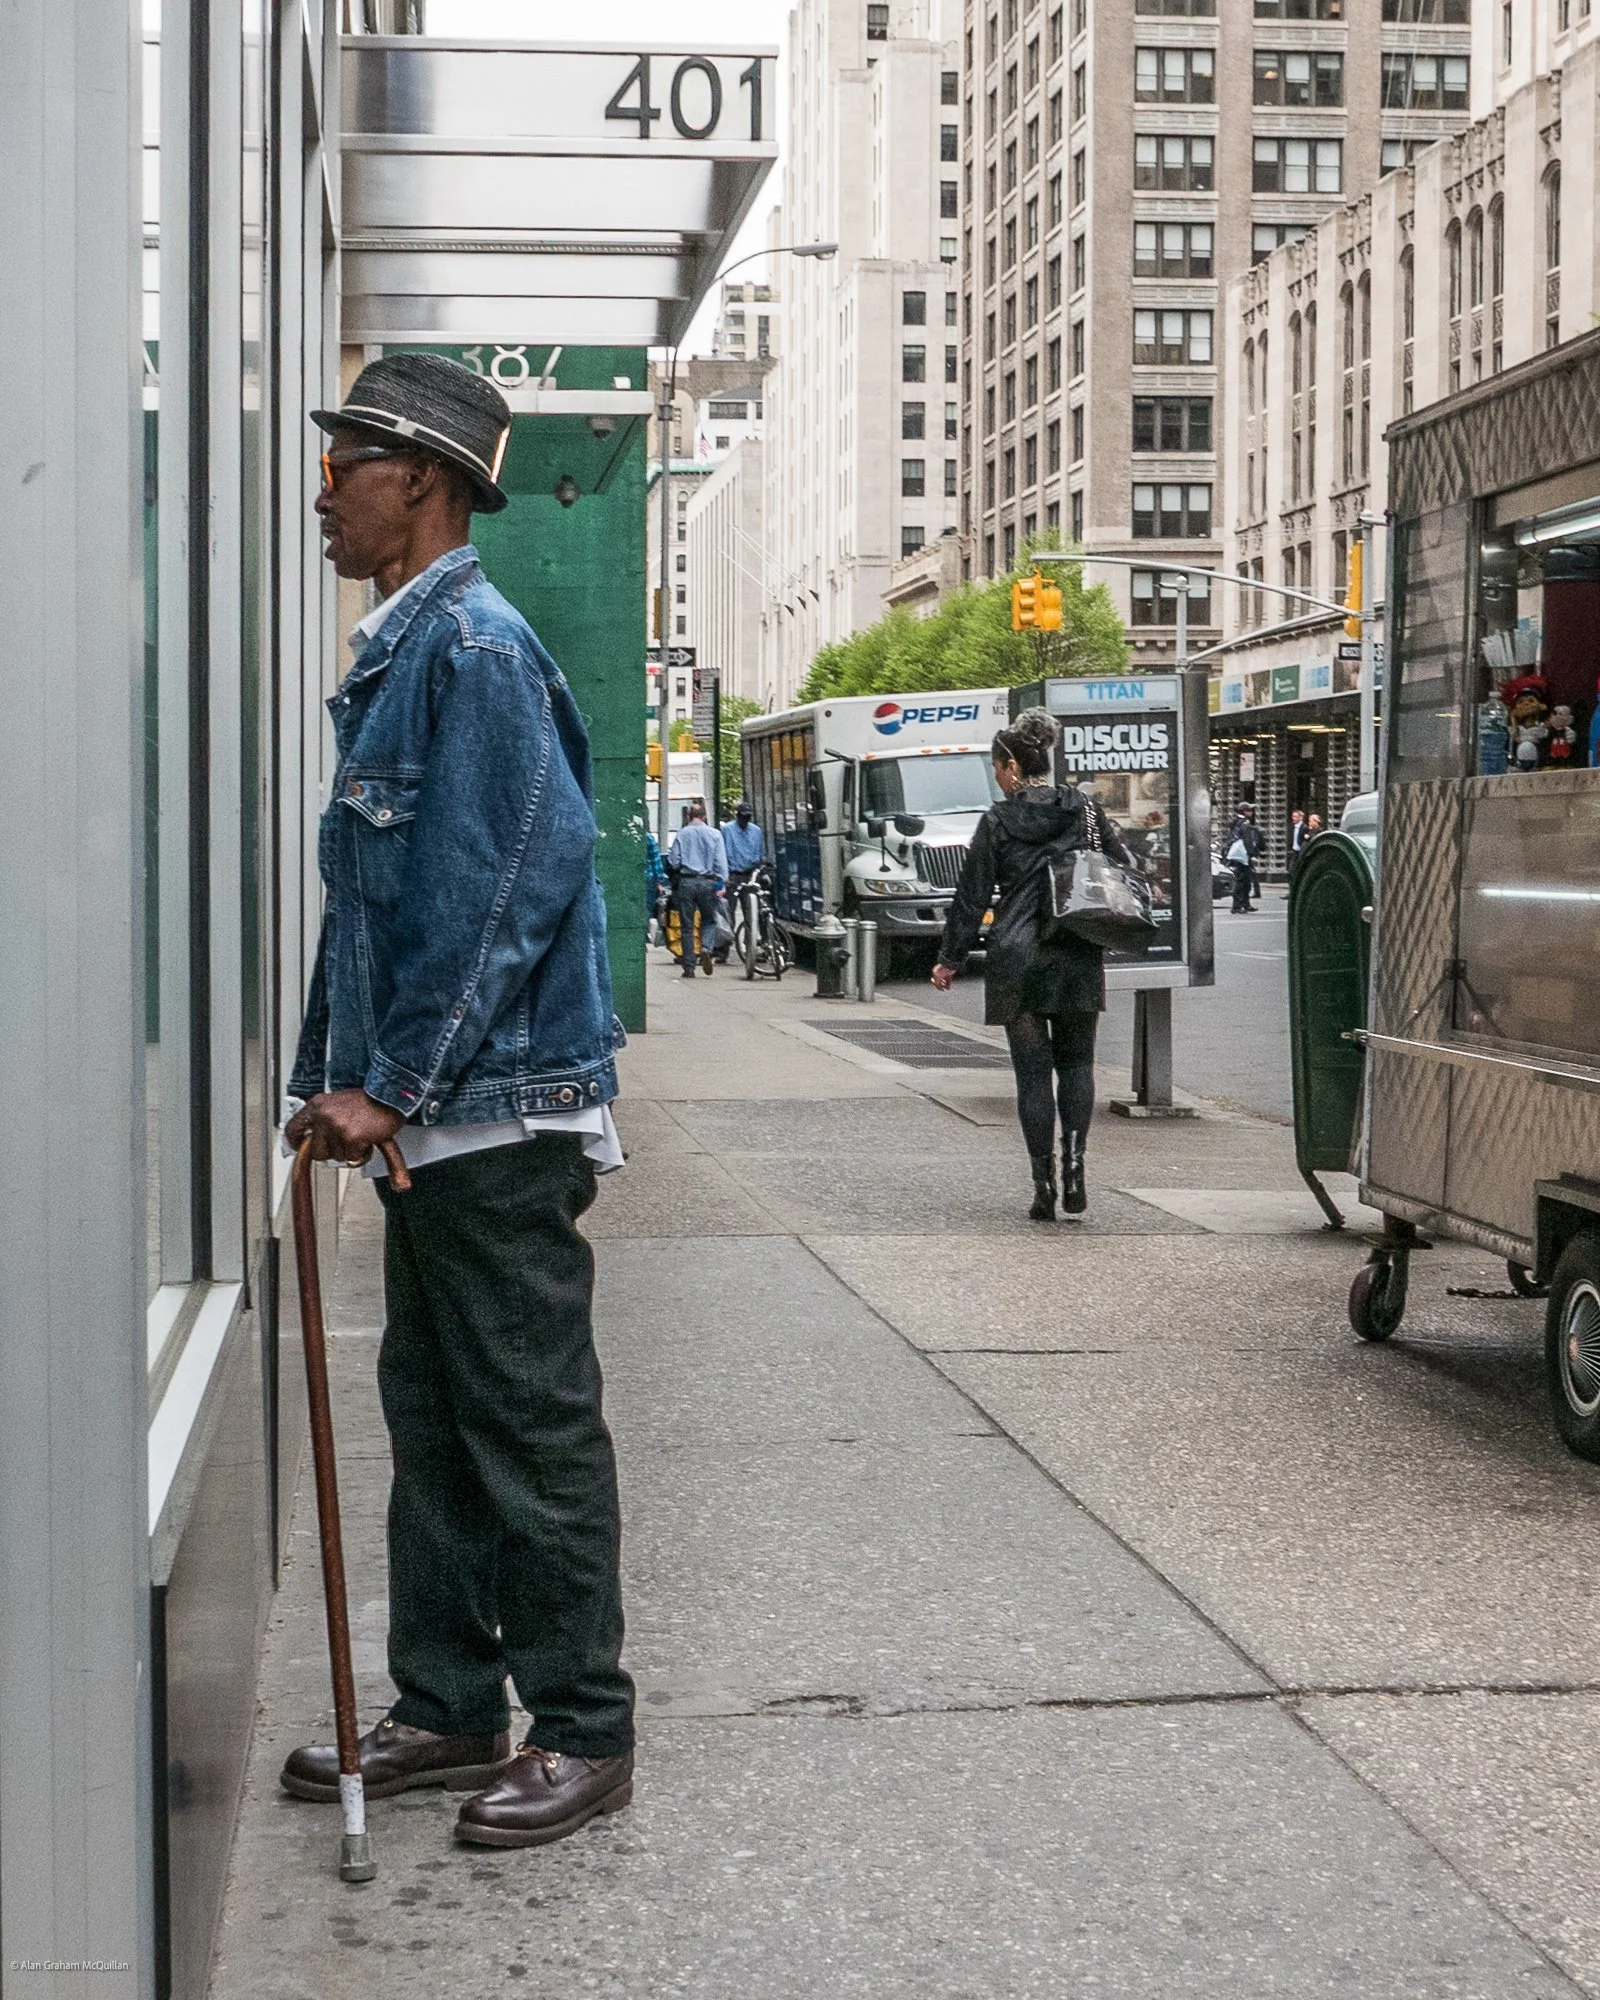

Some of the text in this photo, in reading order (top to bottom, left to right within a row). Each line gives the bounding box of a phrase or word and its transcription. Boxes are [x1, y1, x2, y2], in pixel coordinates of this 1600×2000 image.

[605, 53, 762, 140] 401
[1085, 682, 1145, 700] TITAN
[902, 704, 979, 724] PEPSI
[1063, 723, 1169, 753] DISCUS
[1064, 750, 1169, 771] THROWER
